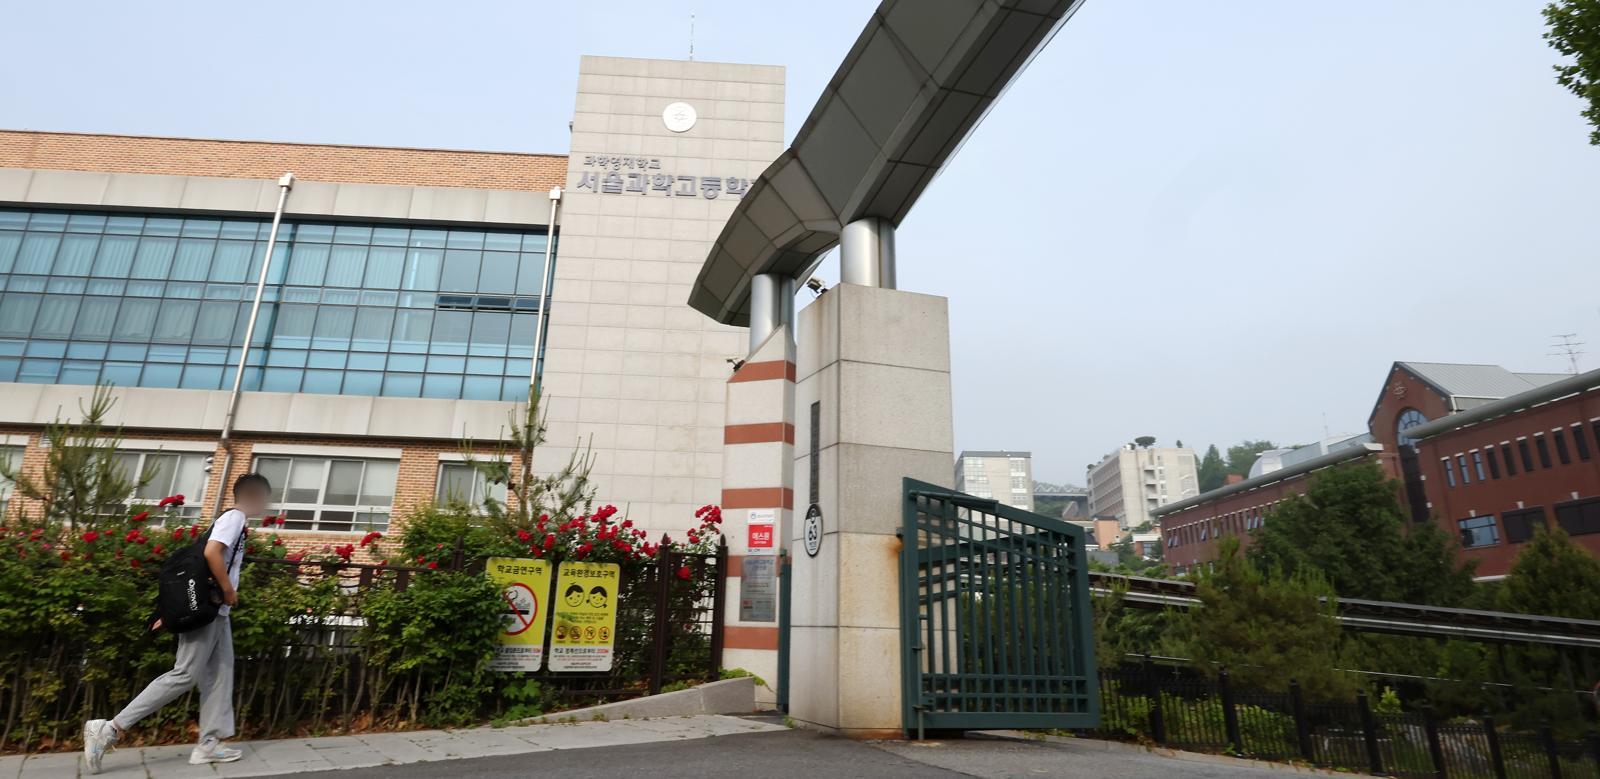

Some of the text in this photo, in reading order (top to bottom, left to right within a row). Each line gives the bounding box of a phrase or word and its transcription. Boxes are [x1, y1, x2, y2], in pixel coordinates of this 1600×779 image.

[583, 155, 661, 171] 과학영재학교
[577, 171, 755, 199] 서울과학고등학
[809, 524, 817, 541] 63
[497, 565, 542, 575] 학교금연구역
[563, 568, 616, 579] 교육환경보호구역
